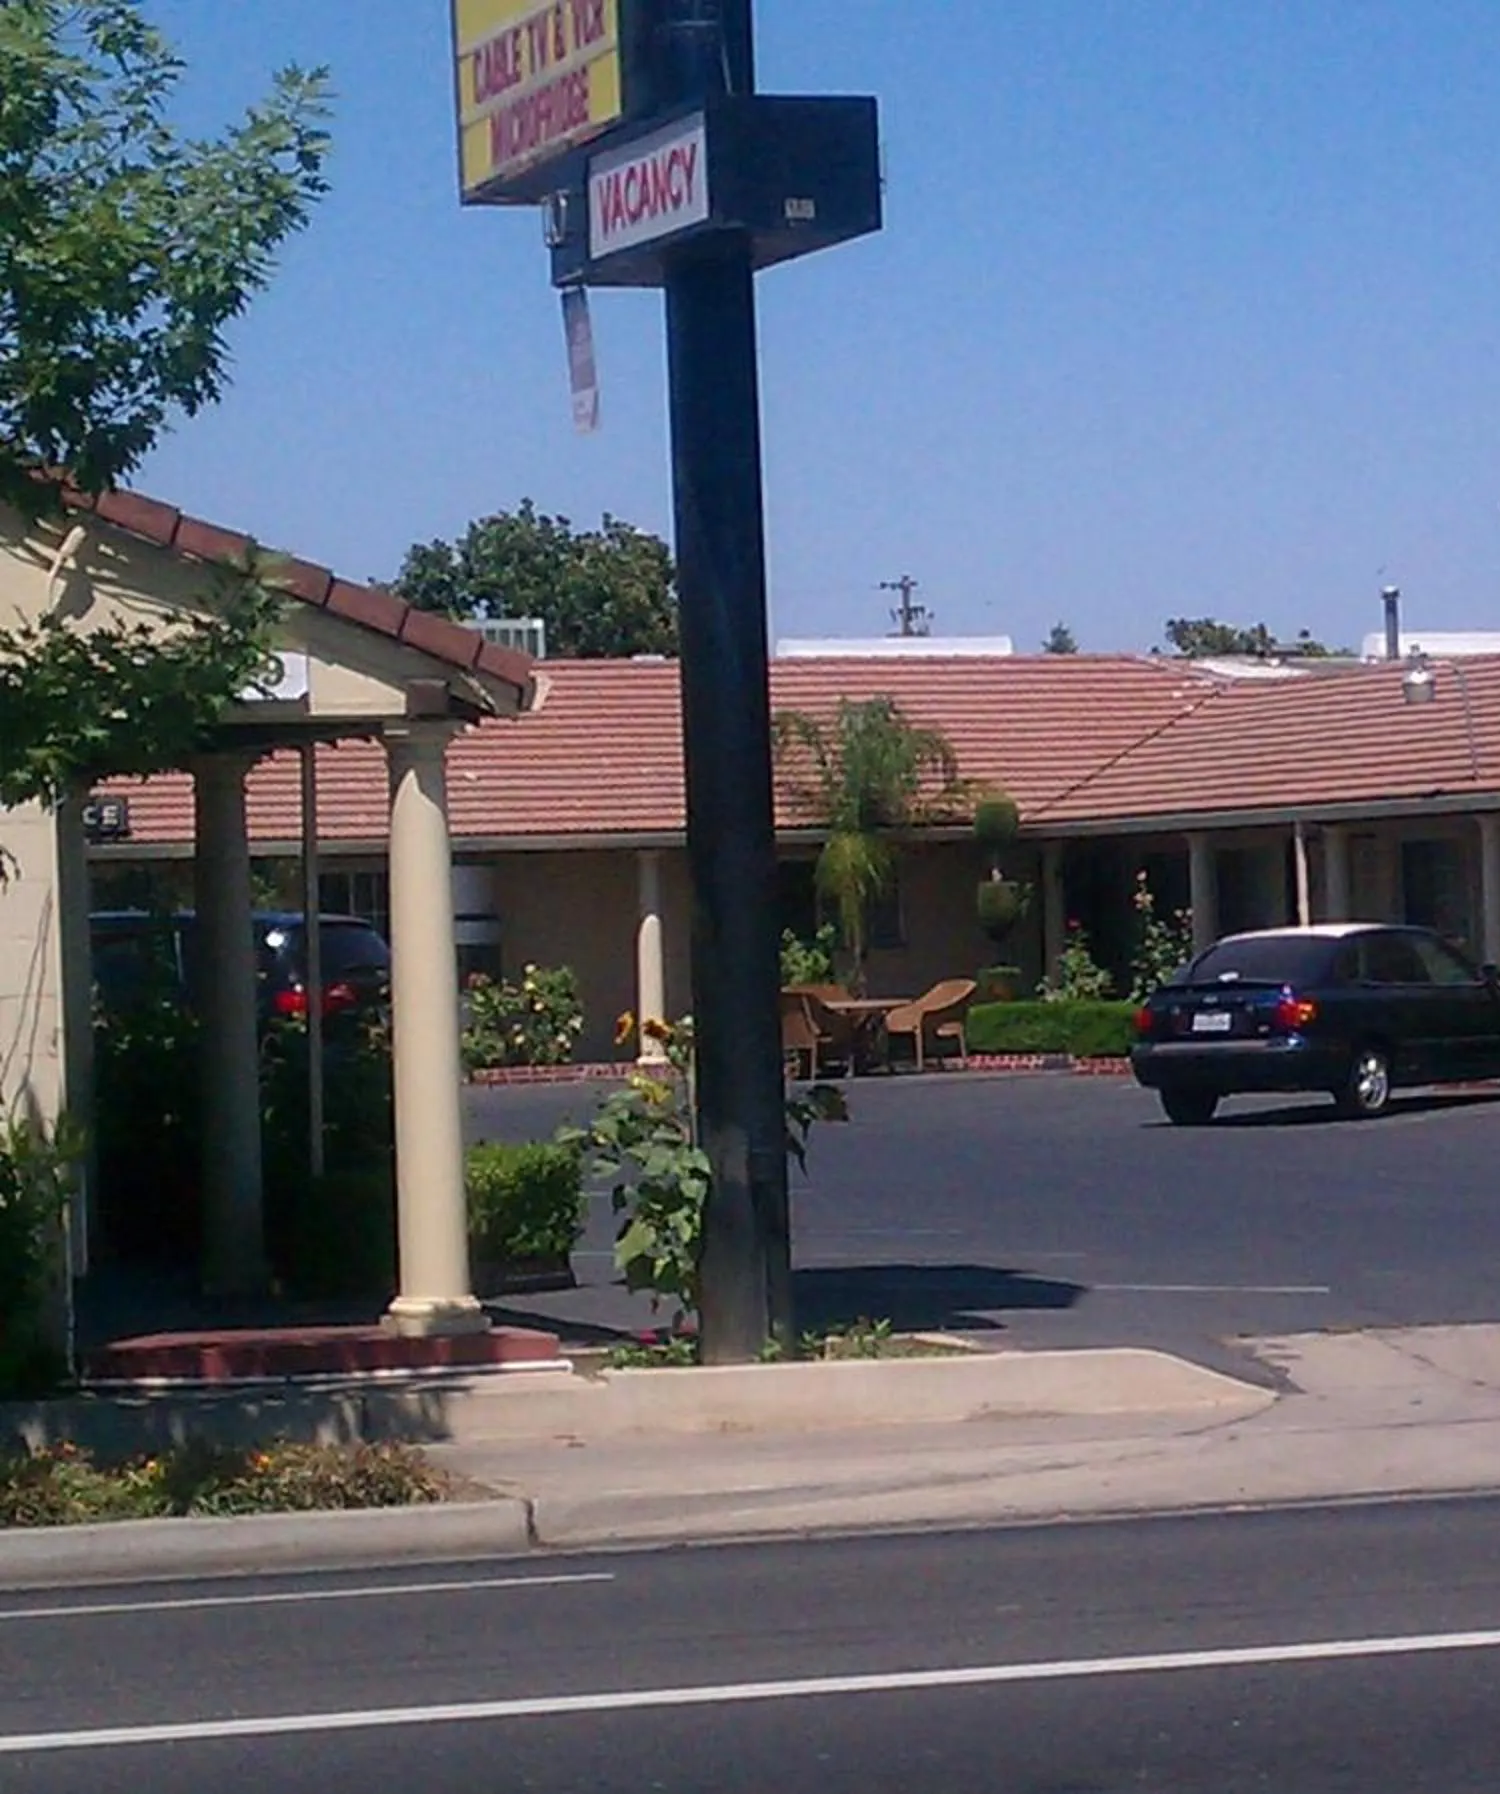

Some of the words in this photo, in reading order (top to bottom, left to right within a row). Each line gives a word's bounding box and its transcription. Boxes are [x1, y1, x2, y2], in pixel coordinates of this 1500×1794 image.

[473, 29, 522, 104] CABLE
[528, 9, 548, 75] TV
[597, 142, 697, 240] VACANCY
